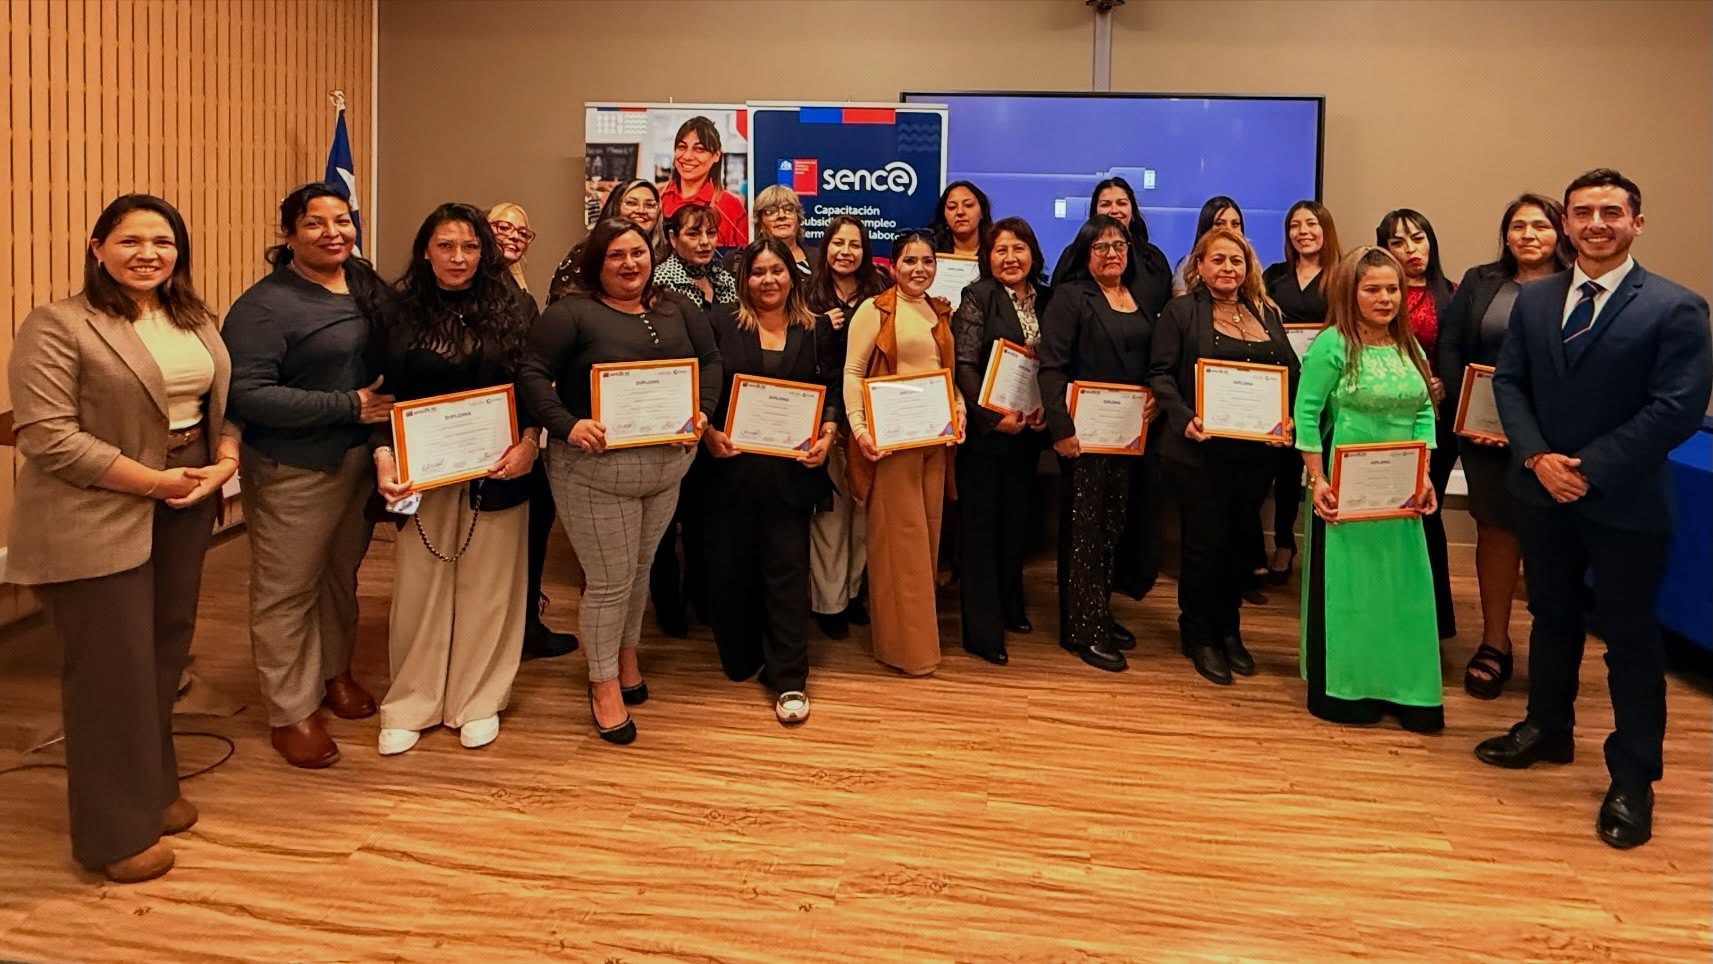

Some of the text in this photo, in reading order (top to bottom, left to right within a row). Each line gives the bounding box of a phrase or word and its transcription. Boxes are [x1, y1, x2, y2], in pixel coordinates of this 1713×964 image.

[822, 161, 918, 197] sence
[814, 204, 881, 217] Capacitación
[860, 217, 897, 230] mpleo
